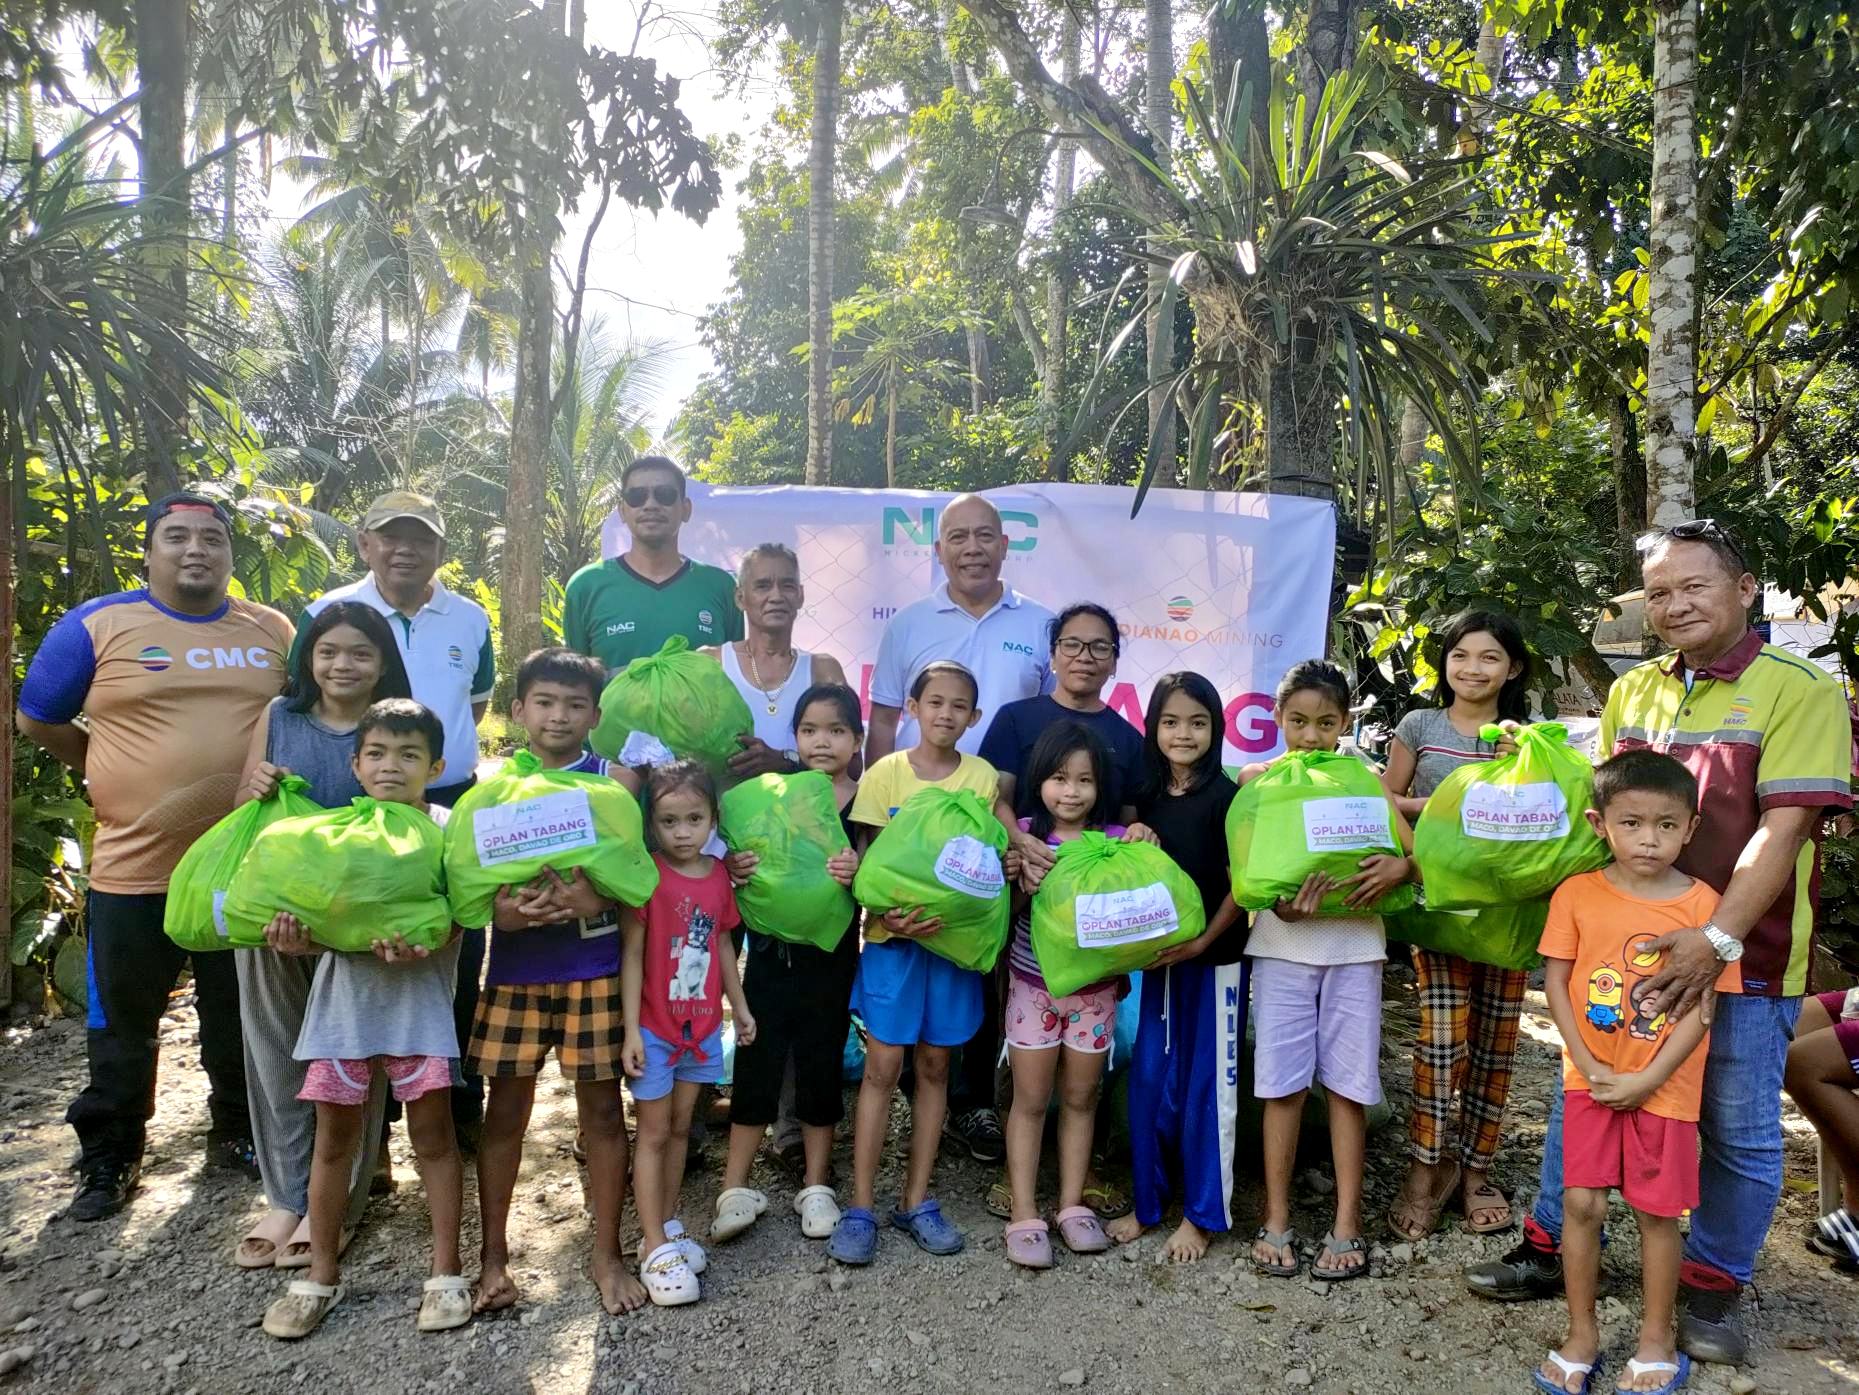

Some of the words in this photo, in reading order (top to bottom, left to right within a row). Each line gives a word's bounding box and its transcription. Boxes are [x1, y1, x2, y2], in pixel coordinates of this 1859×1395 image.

[882, 507, 1038, 551] NC
[606, 621, 635, 633] NAC
[1119, 624, 1199, 643] DIANAO
[1207, 632, 1283, 648] MINING
[185, 647, 270, 670] CMC
[1003, 641, 1033, 655] NAC
[516, 804, 542, 814] NAC
[1466, 808, 1510, 823] OPLAN
[483, 831, 528, 848] OPLAN
[532, 819, 586, 837] TABANG
[1311, 825, 1353, 836] OPLAN
[944, 857, 980, 880] OPLAN
[1081, 919, 1122, 931] OPLAN
[1125, 908, 1170, 926] TABANG
